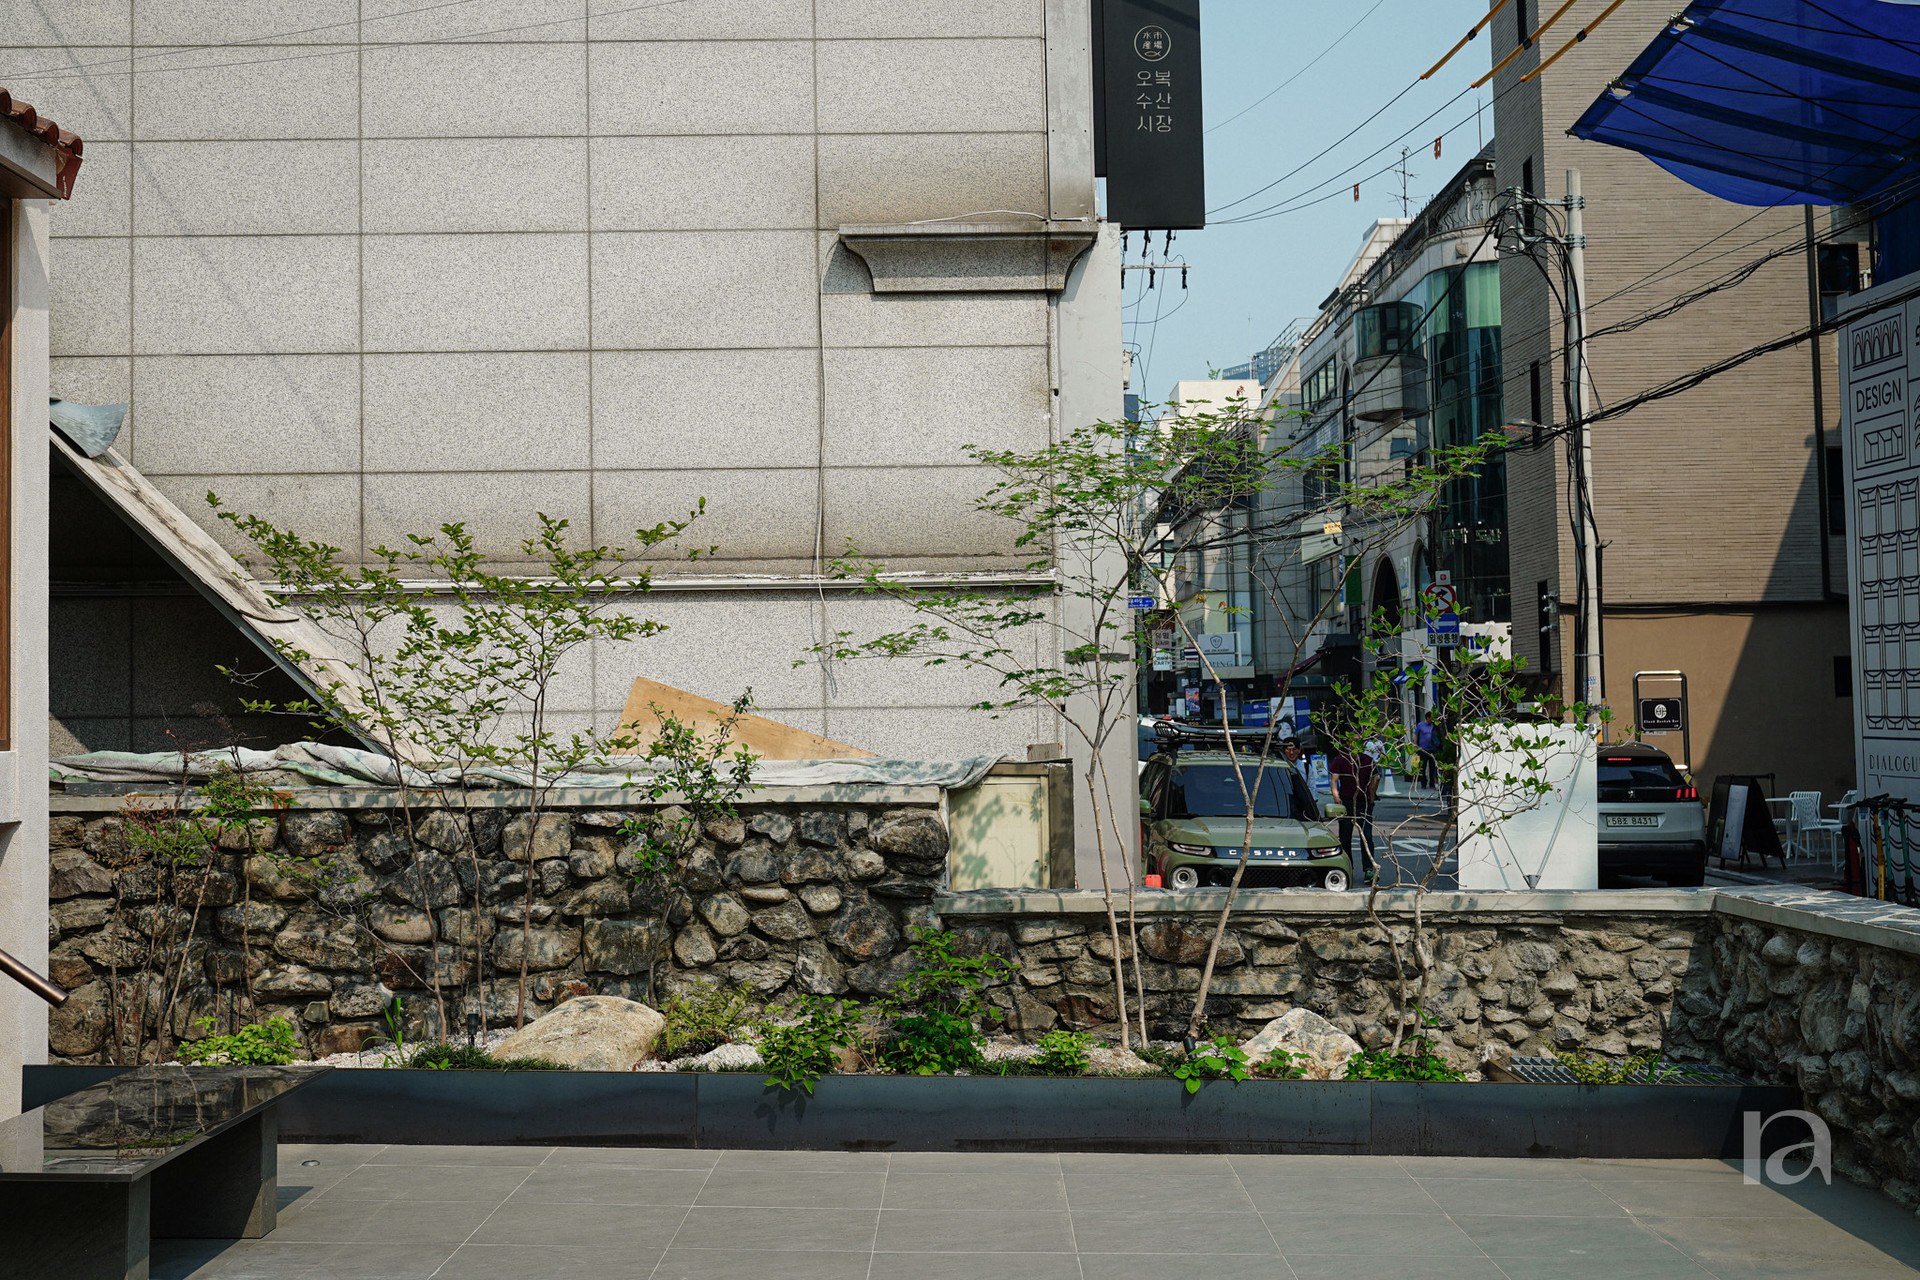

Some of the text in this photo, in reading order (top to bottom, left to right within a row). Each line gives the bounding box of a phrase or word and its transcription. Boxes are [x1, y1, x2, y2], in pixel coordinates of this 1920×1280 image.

[1136, 70, 1171, 87] 오복
[1136, 92, 1172, 110] 수산
[1137, 115, 1172, 133] 시장
[1856, 377, 1902, 413] DESIGN
[1869, 754, 1920, 774] DIALOGU
[1631, 816, 1653, 825] 8431
[1228, 848, 1296, 857] CSPER
